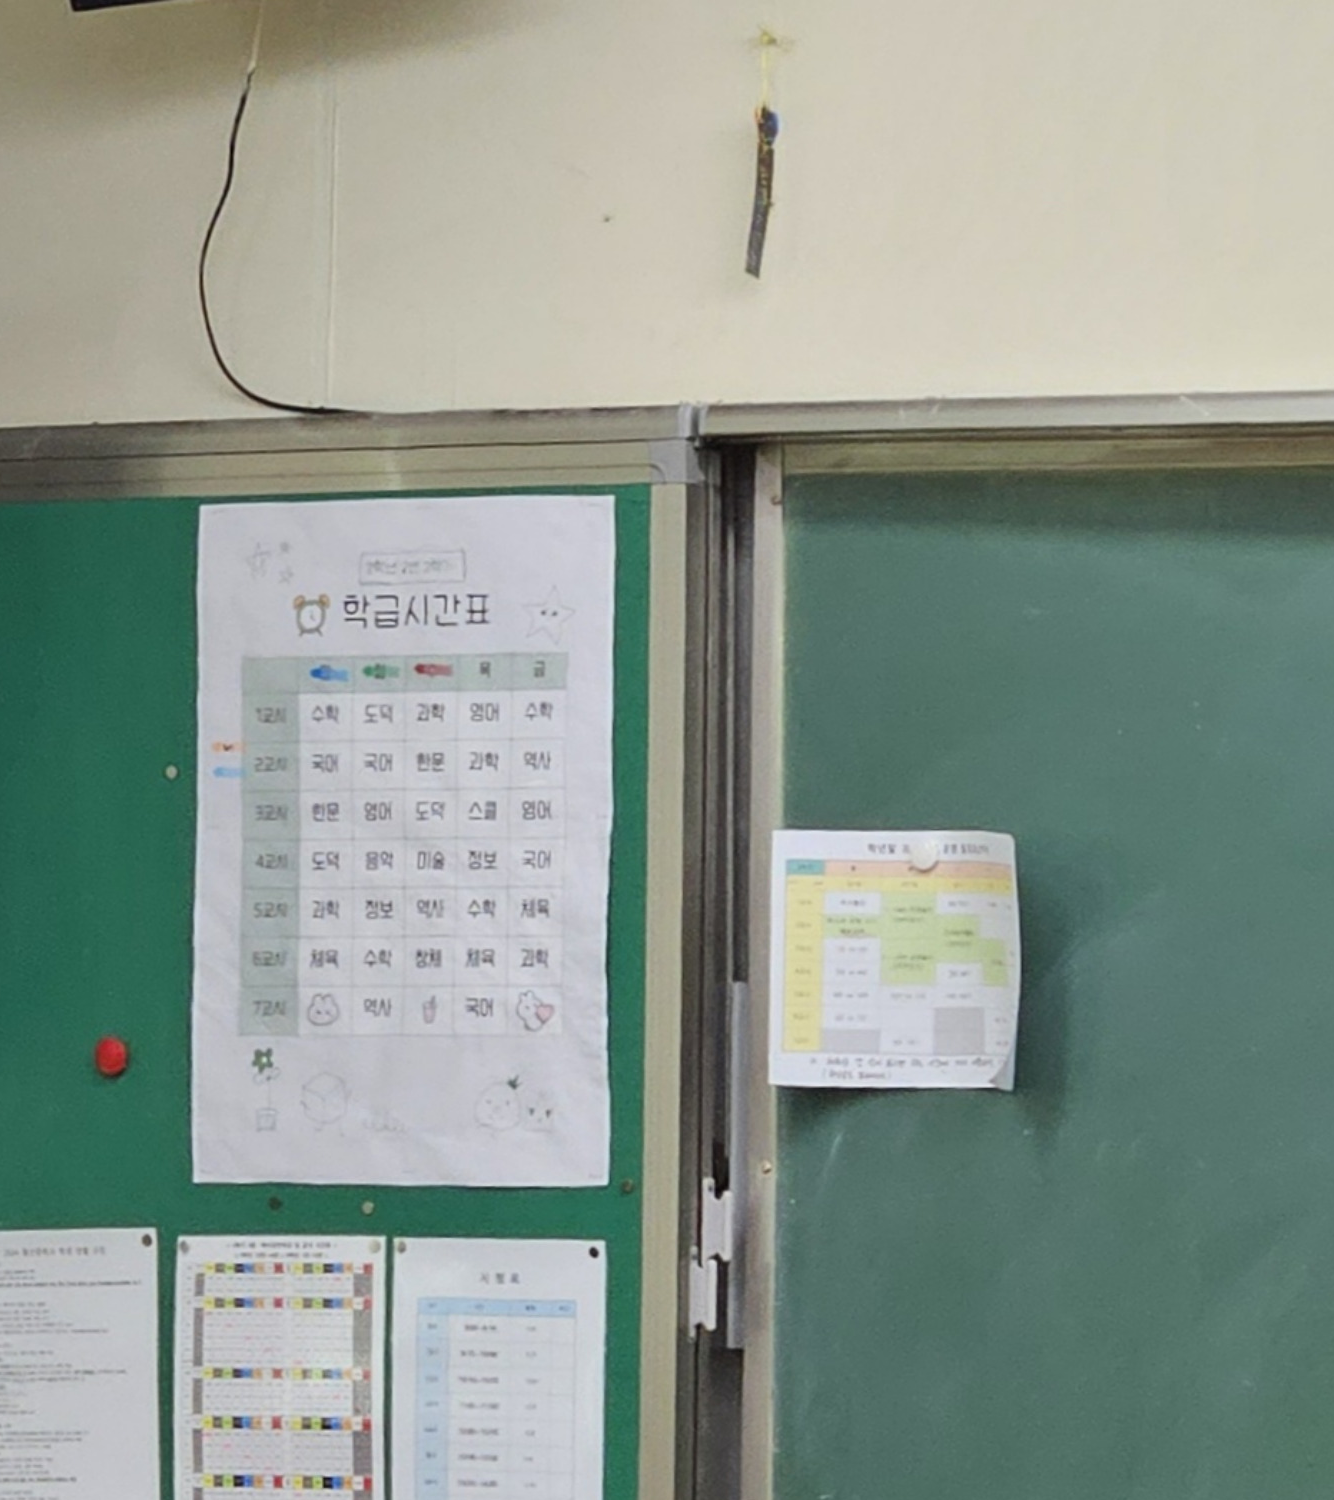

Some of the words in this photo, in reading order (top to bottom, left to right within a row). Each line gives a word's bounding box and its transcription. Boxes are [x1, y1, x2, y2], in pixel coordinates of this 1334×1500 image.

[344, 594, 489, 629] 학급시간표
[533, 660, 546, 677] 금
[312, 704, 339, 723] 수학
[364, 704, 393, 723] 도덕
[417, 703, 445, 722] 과학
[470, 703, 499, 722] 영어
[525, 702, 553, 721] 수학
[312, 754, 339, 773] 국어
[364, 754, 393, 773] 국어
[417, 752, 445, 772] 한문
[469, 752, 499, 771] 과학
[312, 802, 340, 822] 한문
[364, 802, 392, 822] 영어
[417, 801, 445, 820] 도덕
[522, 800, 553, 820] 영어
[312, 852, 340, 871] 도덕
[417, 851, 445, 870] 미술
[468, 851, 497, 870] 정보
[522, 850, 552, 869] 국어
[312, 900, 340, 919] 과학
[365, 900, 394, 919] 정보
[467, 899, 496, 918] 수학
[364, 949, 392, 968] 수학
[520, 949, 549, 968] 과학
[364, 999, 392, 1017] 역사
[466, 999, 494, 1017] 국어
